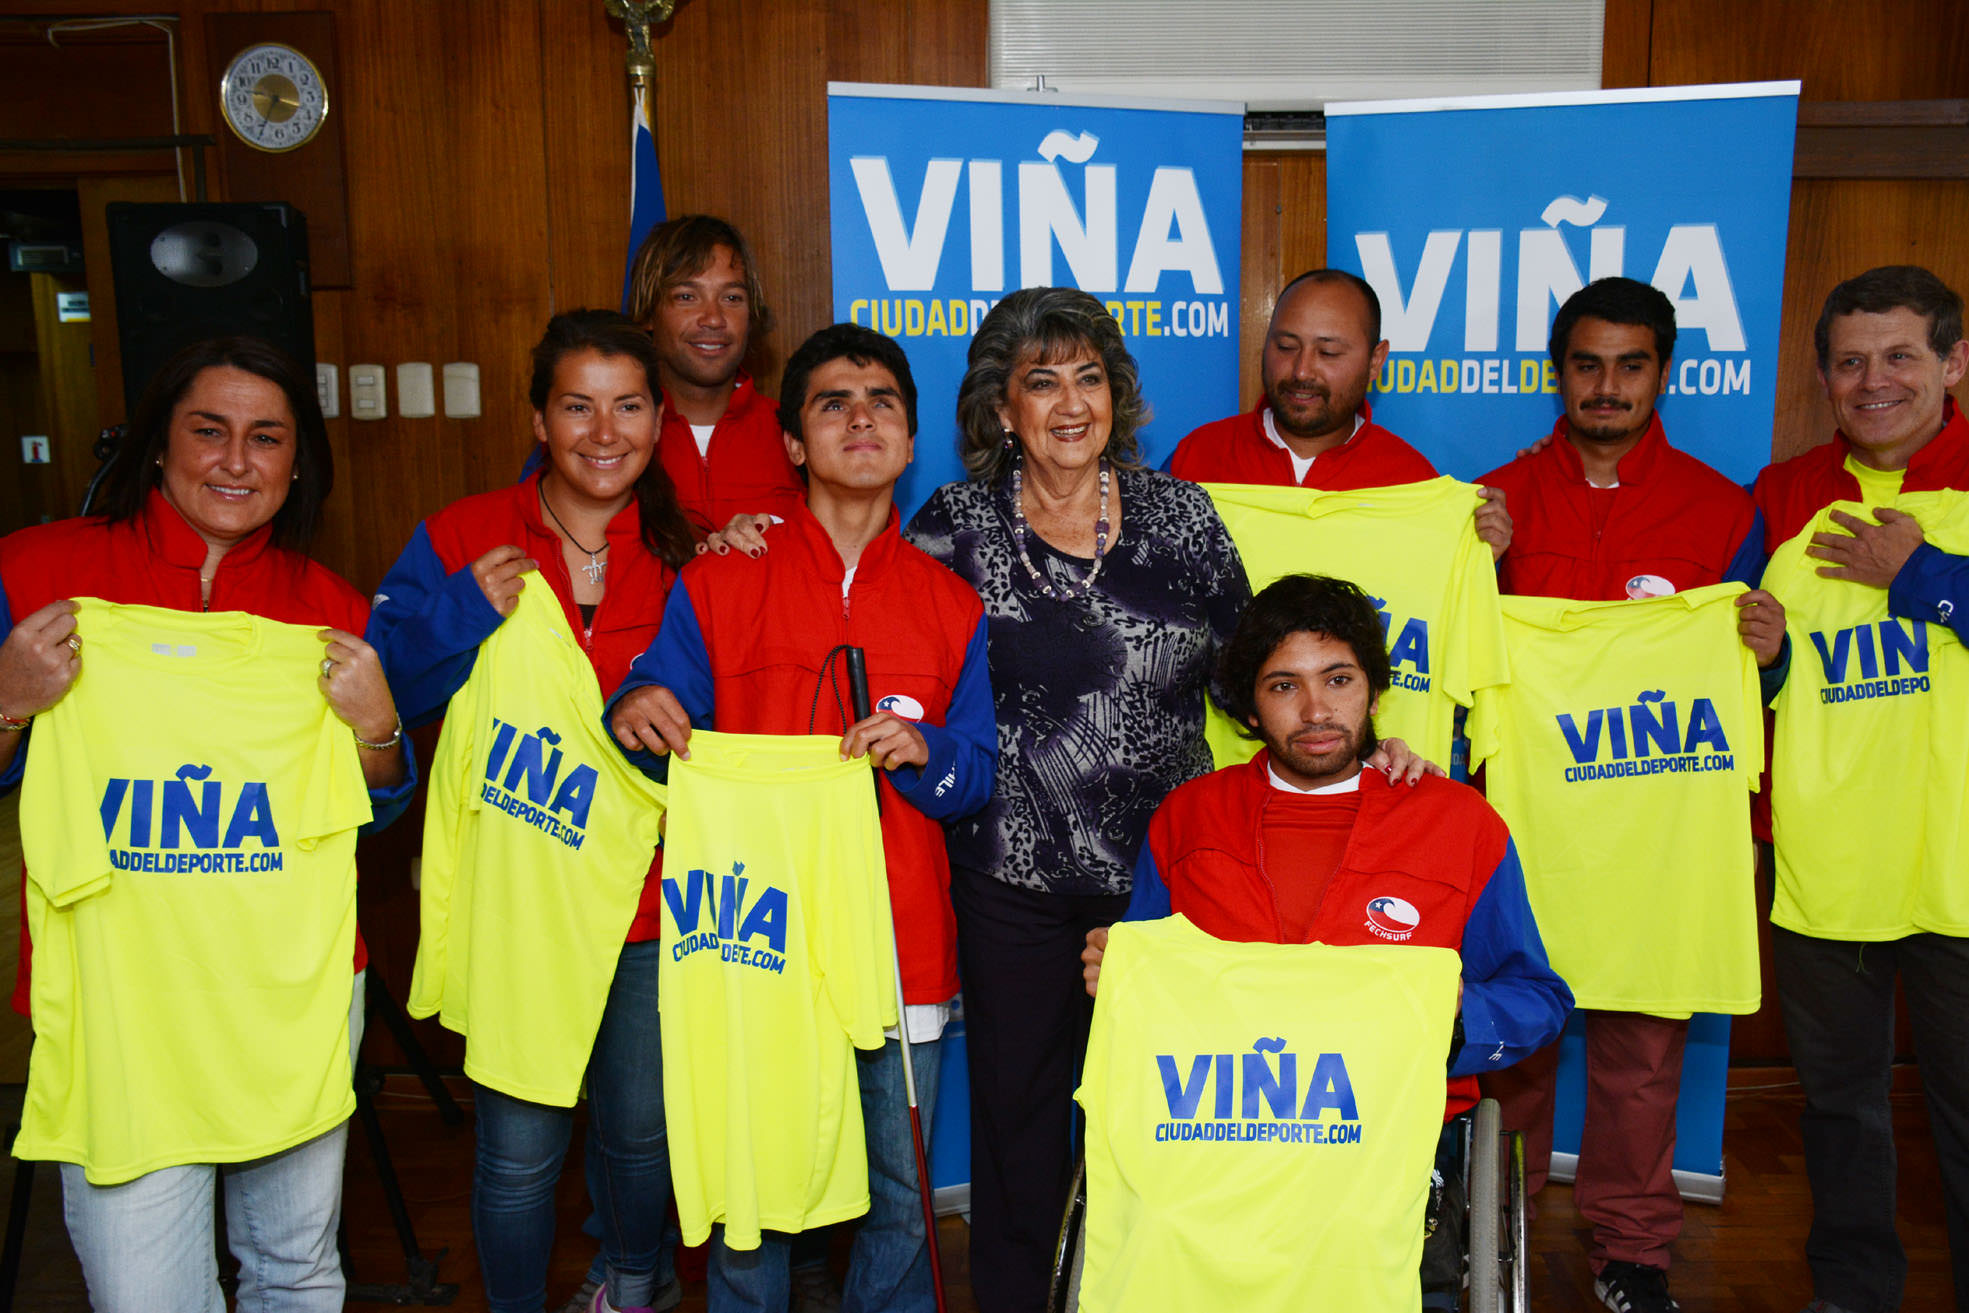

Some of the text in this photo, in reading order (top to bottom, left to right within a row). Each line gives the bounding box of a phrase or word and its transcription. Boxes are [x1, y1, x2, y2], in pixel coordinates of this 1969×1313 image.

[250, 61, 261, 74] 11
[266, 57, 280, 69] 12
[850, 129, 1225, 295] VIÑA
[1354, 193, 1747, 353] VIÑA
[850, 299, 1229, 338] CIUDADDRTE.COM
[1366, 358, 1752, 396] UDADDELDE.COM
[1556, 689, 1731, 765] VIÑA
[485, 717, 599, 830] IÑA
[1565, 754, 1735, 783] CIUDADDELDEPORTE.COM
[109, 849, 283, 874] ADDELDEPORTE.COM
[1364, 920, 1412, 941] FECHSURF
[1156, 1036, 1360, 1121] VIÑA
[1155, 1122, 1362, 1144] CIUDADDELDEPORTE.COM
